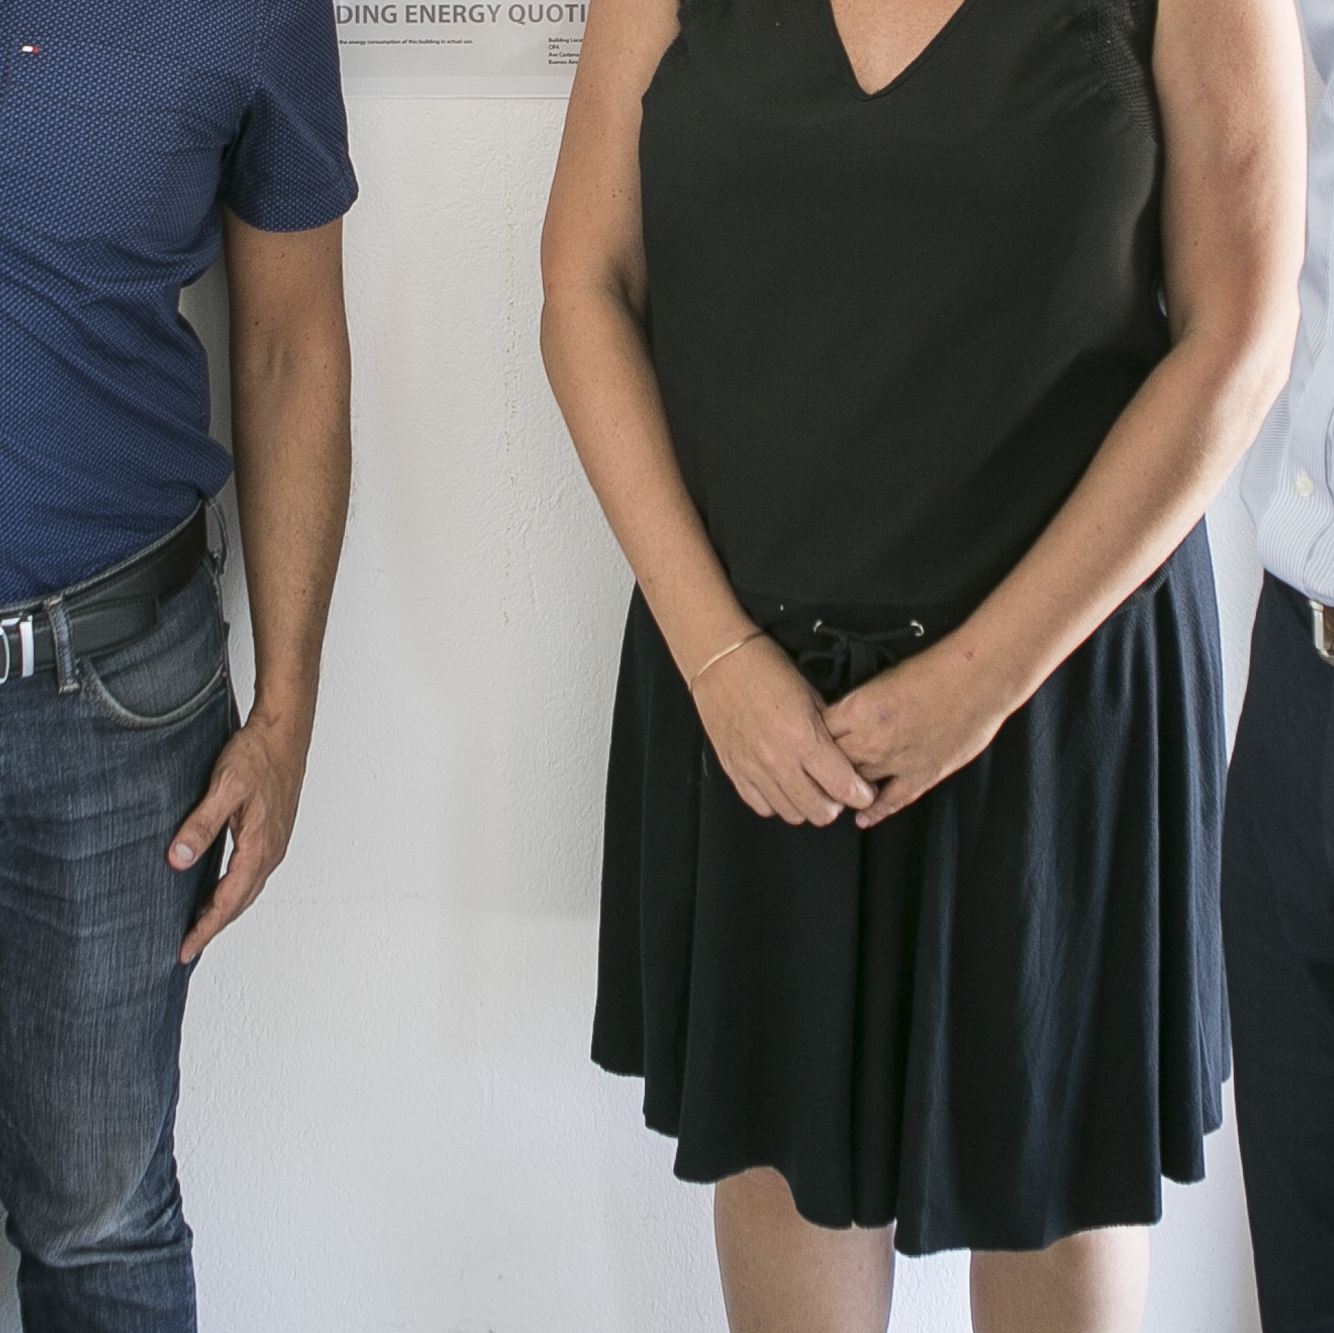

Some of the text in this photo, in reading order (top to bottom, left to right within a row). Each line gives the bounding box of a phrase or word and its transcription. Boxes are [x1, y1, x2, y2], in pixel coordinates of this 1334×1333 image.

[336, 3, 586, 26] DING ENERGY QUOTI
